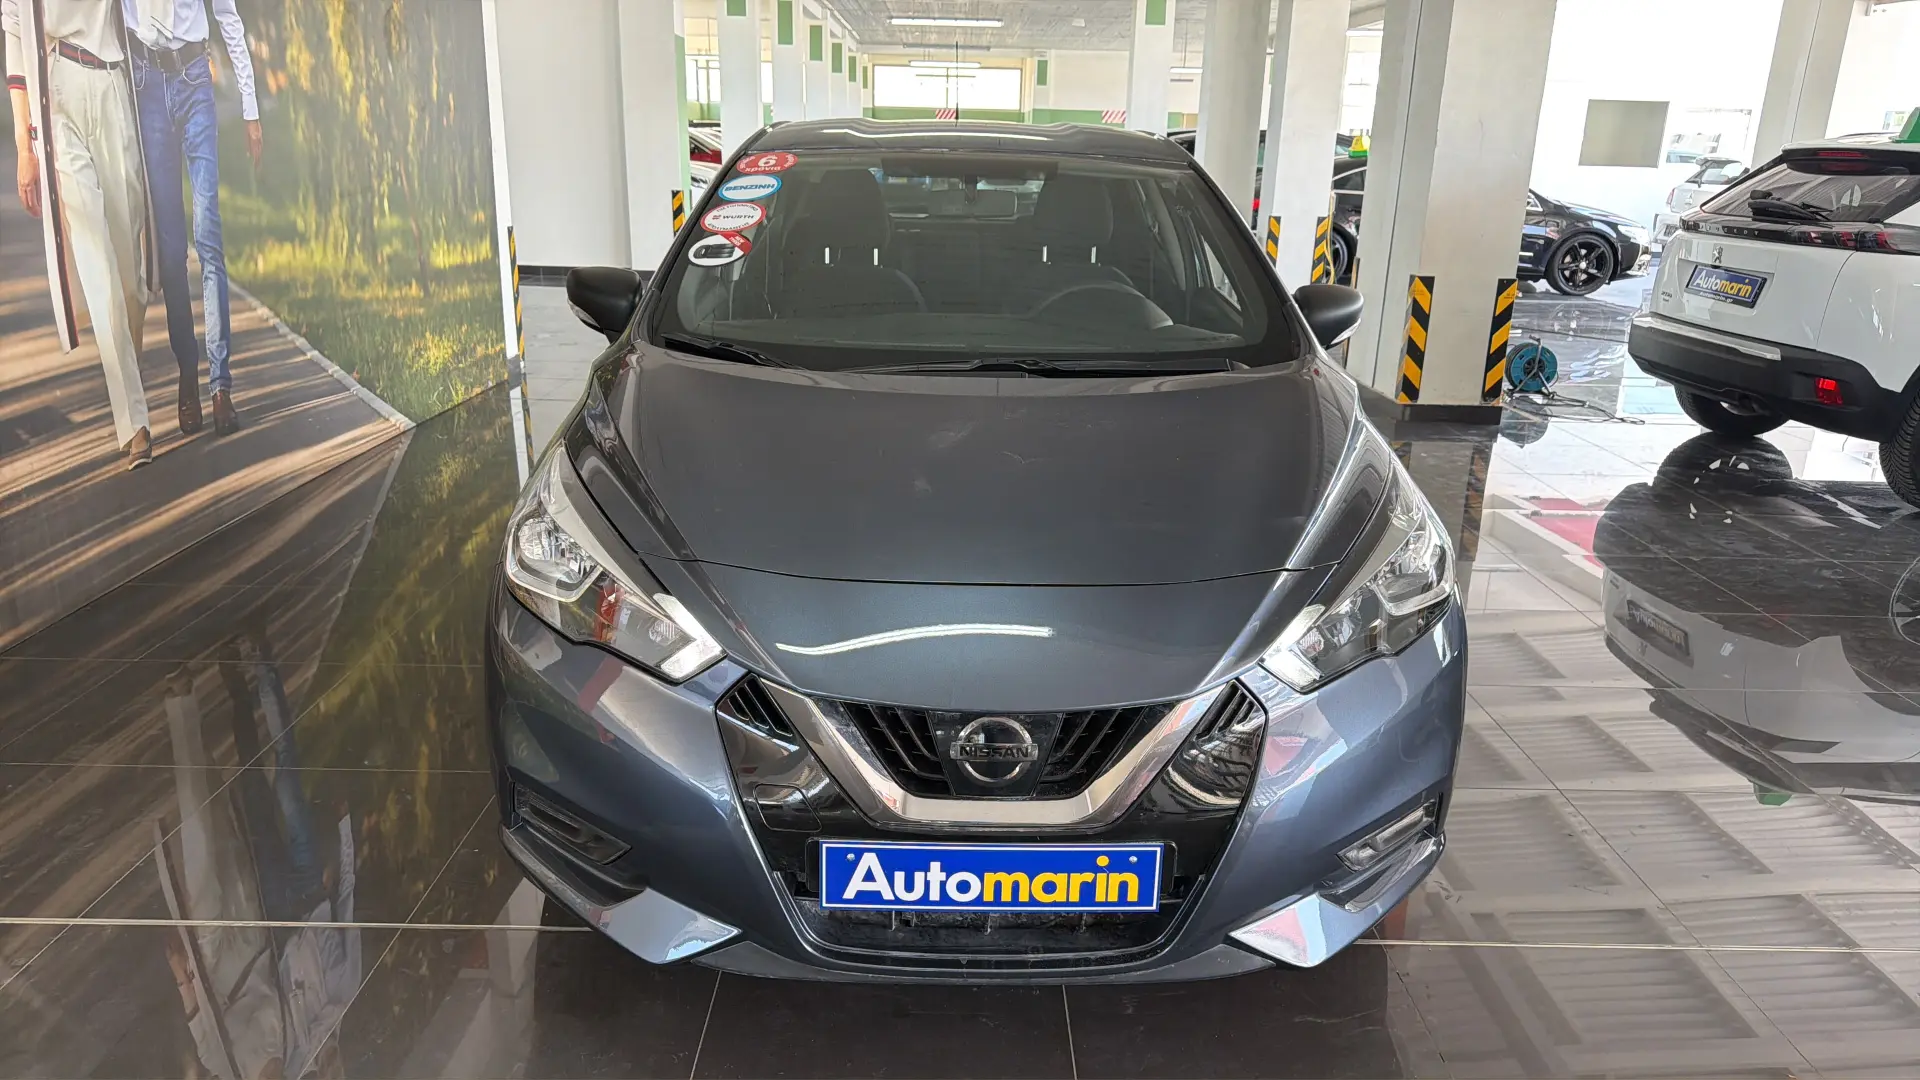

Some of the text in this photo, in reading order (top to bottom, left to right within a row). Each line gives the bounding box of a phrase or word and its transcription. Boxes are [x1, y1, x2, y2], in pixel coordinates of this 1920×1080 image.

[757, 155, 778, 167] 6
[1694, 269, 1752, 298] Automarin
[959, 745, 1029, 758] NISSAN
[842, 851, 1140, 904] Automarin
